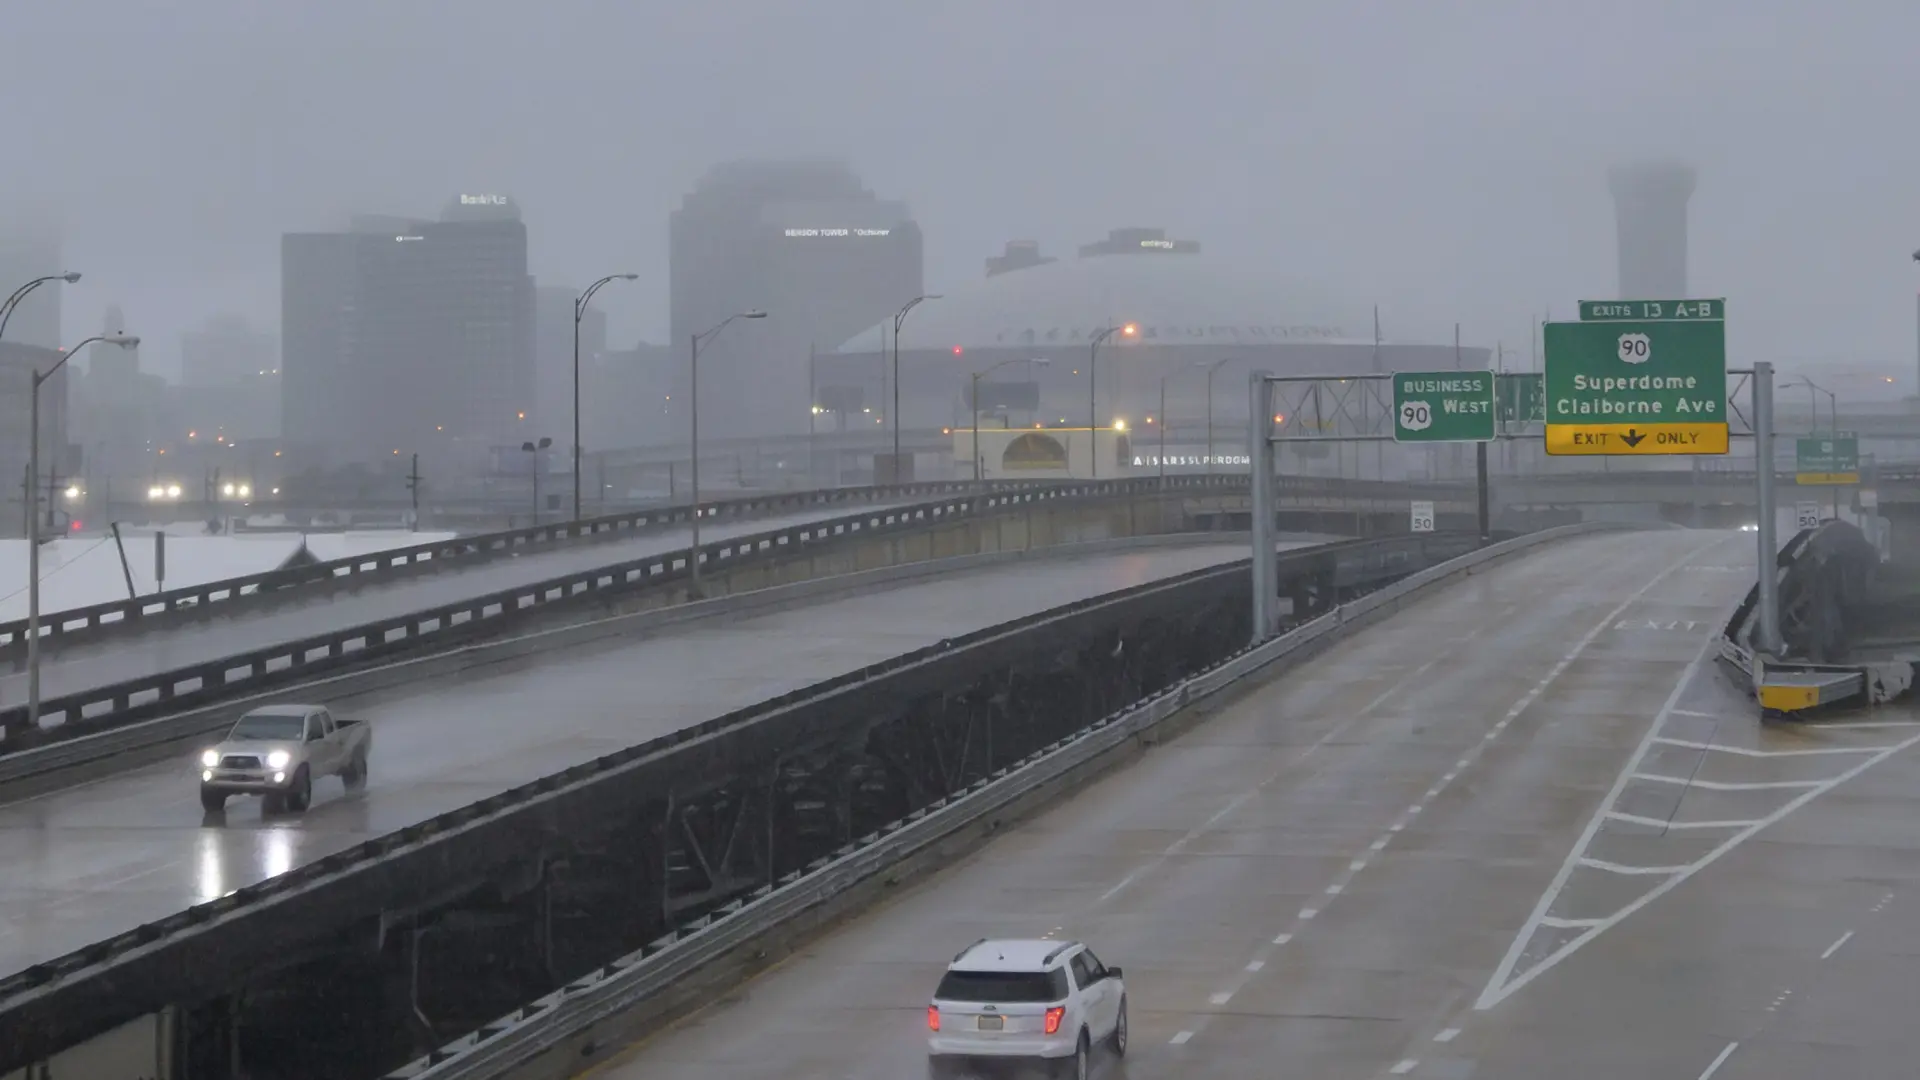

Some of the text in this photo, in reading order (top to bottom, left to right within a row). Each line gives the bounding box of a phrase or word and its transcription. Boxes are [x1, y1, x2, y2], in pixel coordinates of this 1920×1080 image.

[820, 228, 848, 237] TOWER
[1592, 302, 1712, 318] EXITS 13 A-B
[1621, 339, 1648, 357] 90
[1403, 379, 1484, 393] BUSINESS
[1573, 374, 1698, 393] Superdome
[1556, 397, 1717, 415] Claiborne Ave
[1403, 406, 1429, 424] 90
[1573, 432, 1700, 446] EXIT ONLY
[1414, 518, 1432, 529] 50
[1799, 516, 1817, 527] 50
